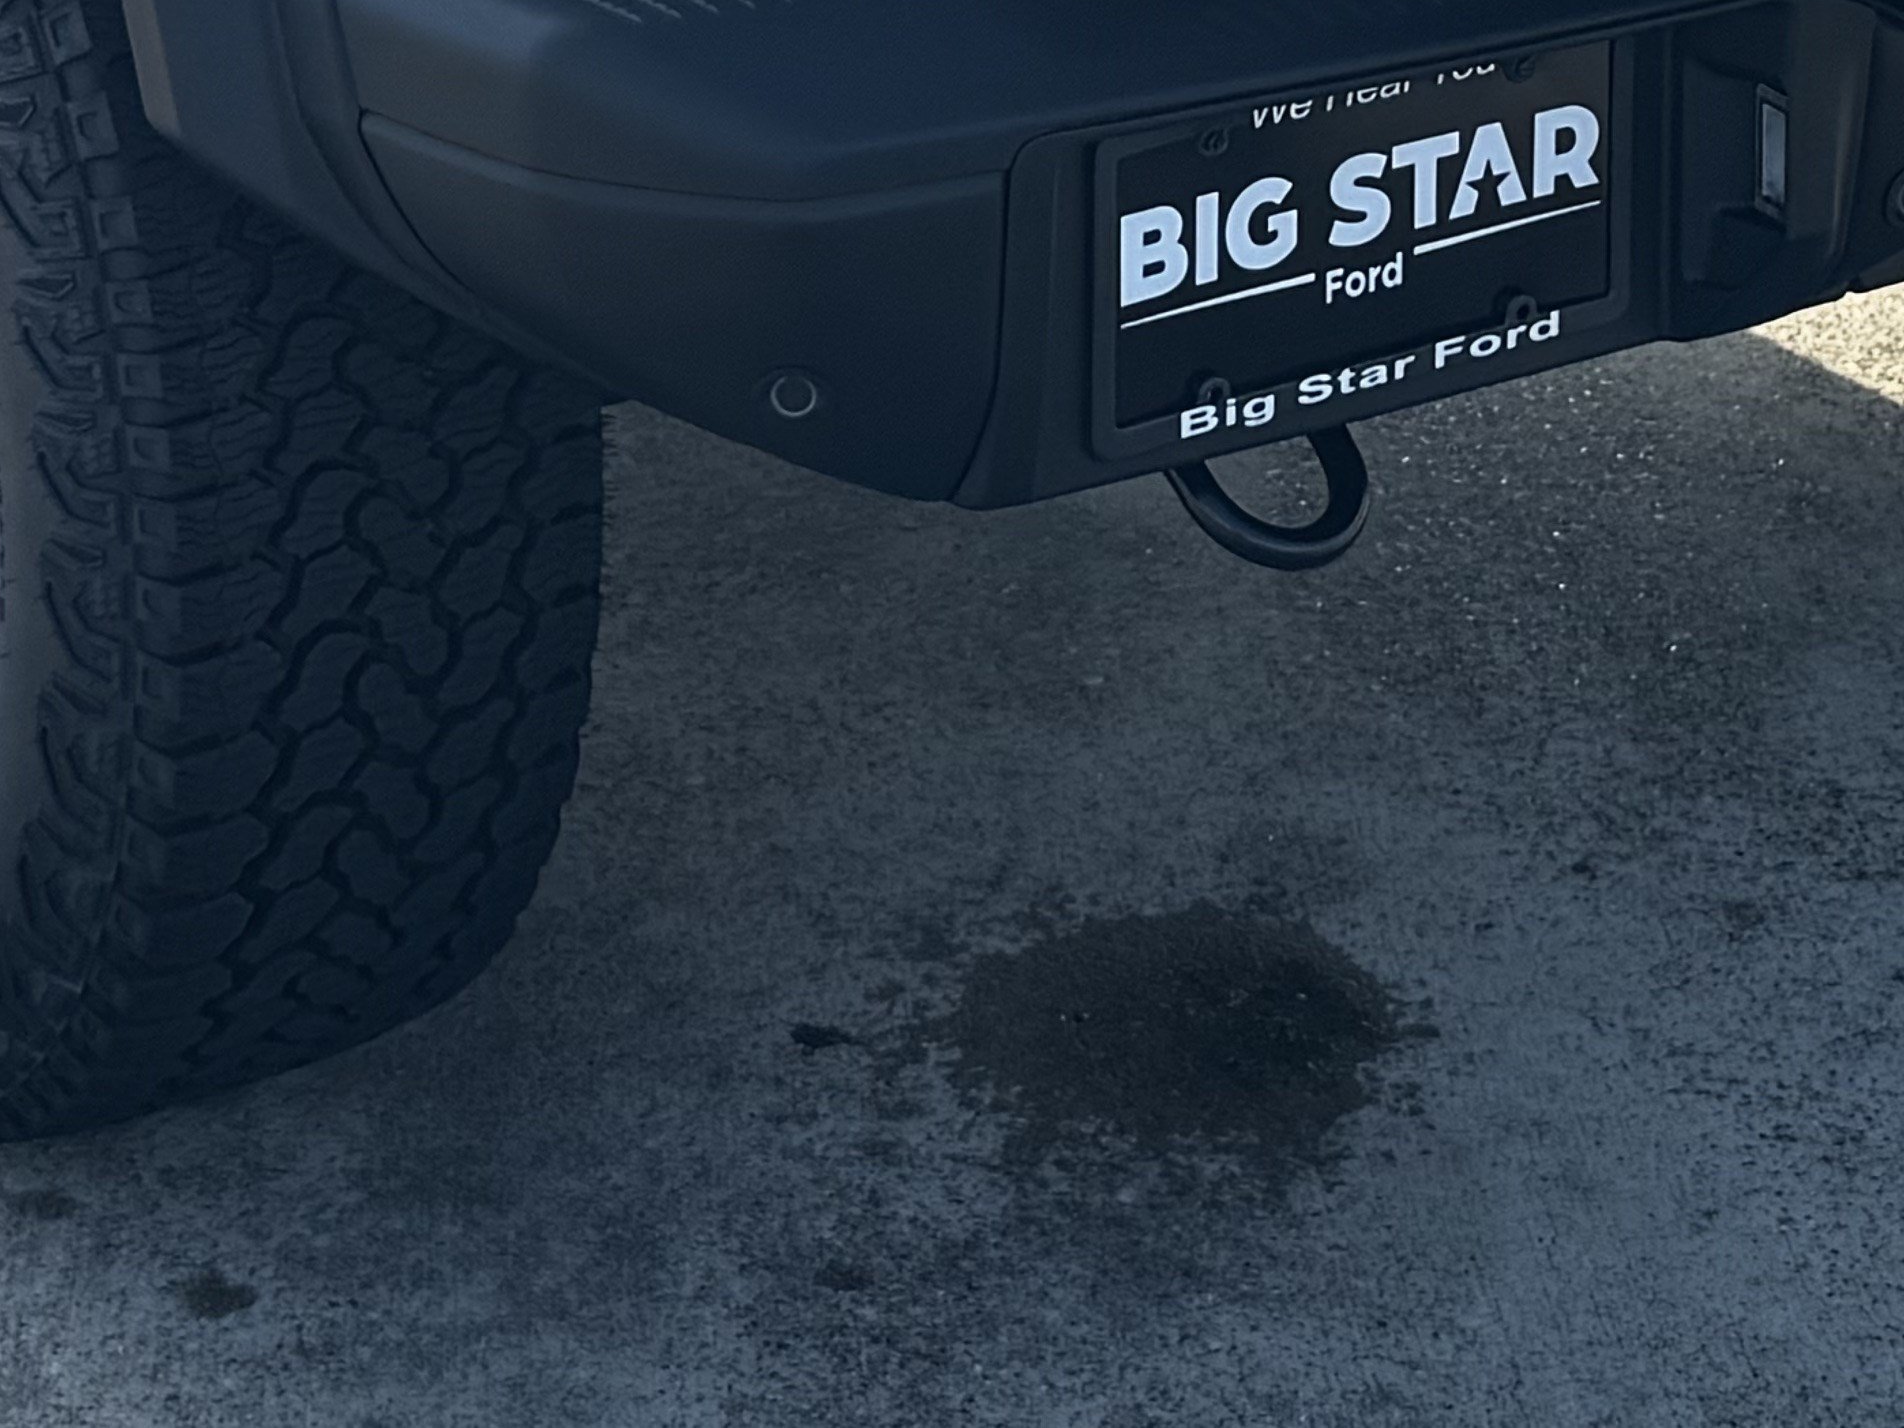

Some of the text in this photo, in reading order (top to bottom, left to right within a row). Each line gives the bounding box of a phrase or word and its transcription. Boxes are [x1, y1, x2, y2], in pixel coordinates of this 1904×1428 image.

[1119, 104, 1601, 308] BIG STAR
[1323, 251, 1404, 304] Ford
[1179, 309, 1561, 439] Big Star Ford
